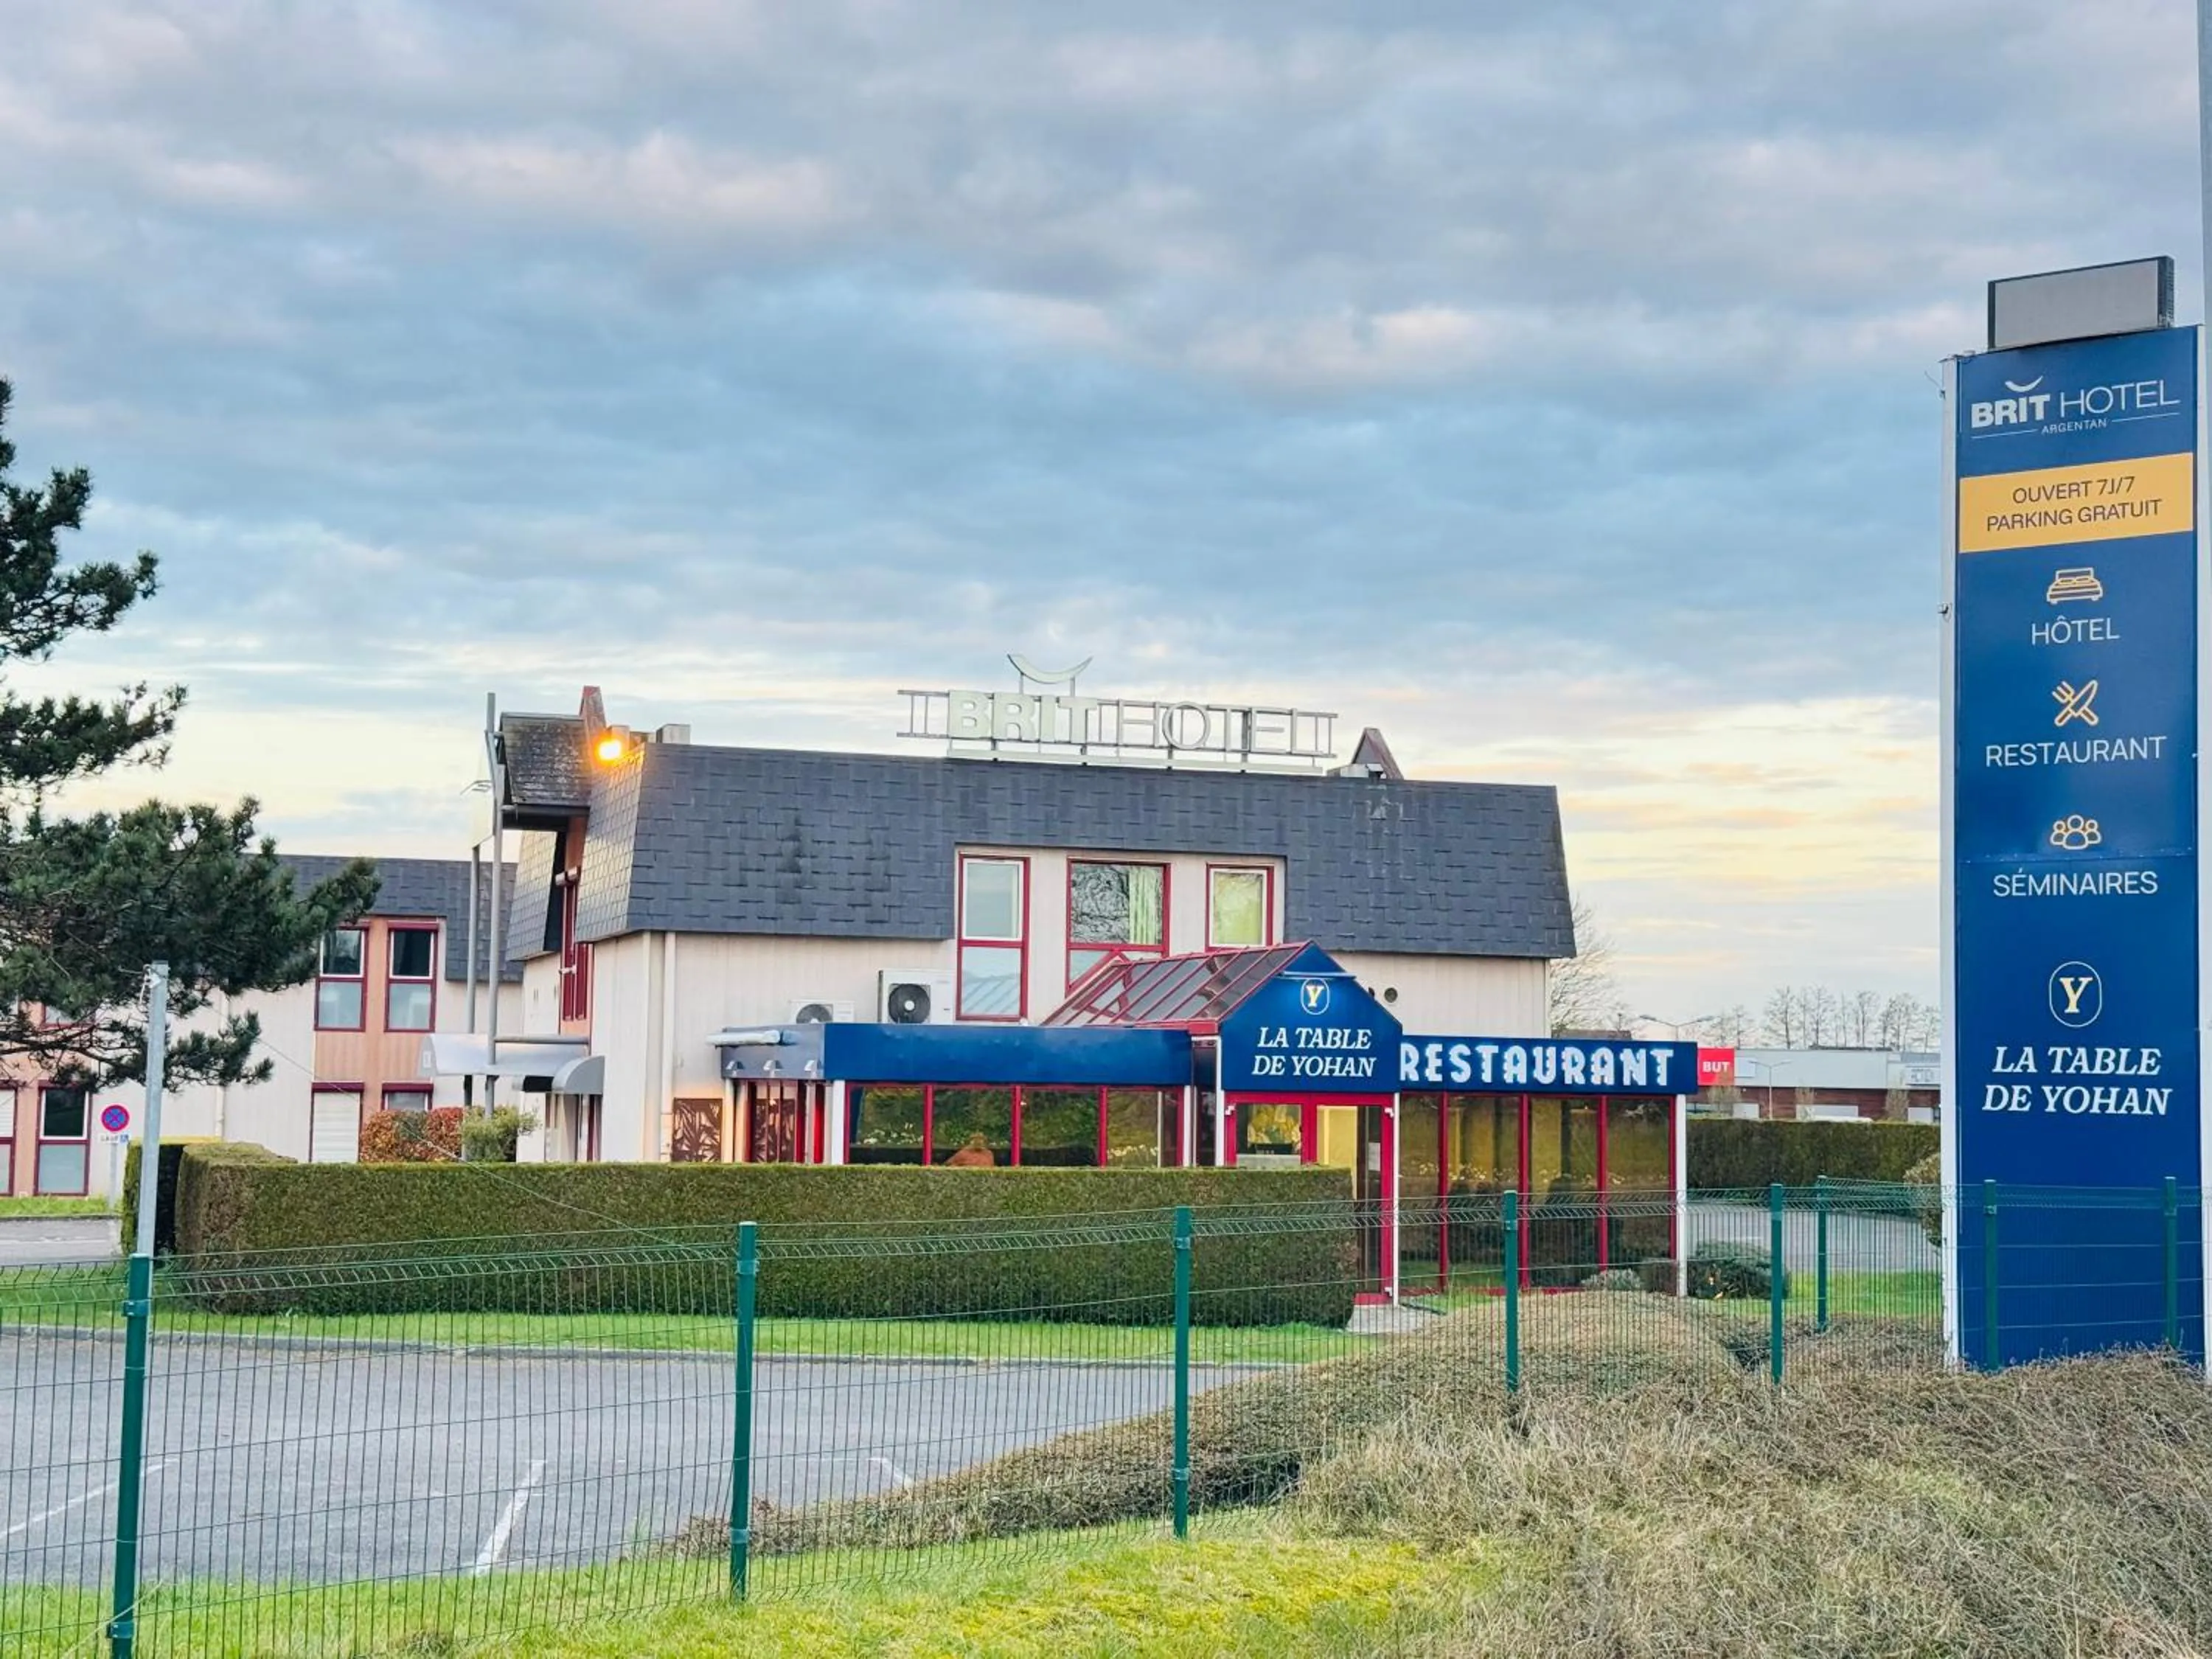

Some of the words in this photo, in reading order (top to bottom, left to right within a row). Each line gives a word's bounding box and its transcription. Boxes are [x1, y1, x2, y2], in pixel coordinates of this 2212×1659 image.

[1971, 394, 2050, 429] BRIT
[2060, 380, 2180, 418] HOTEL
[2041, 418, 2108, 435] ARGENTAN
[2012, 480, 2093, 504] OUVERT
[2096, 476, 2136, 495] 7J/7
[1986, 508, 2073, 532] PARKING
[2078, 498, 2162, 523] GRATUIT
[2031, 615, 2120, 645] HÔTEL
[947, 689, 1099, 744] BRIT
[1117, 700, 1324, 755] HOTEL
[1986, 736, 2167, 768] RESTAURANT
[1993, 868, 2158, 897] SÉMINAIRES
[1305, 984, 1325, 1008] Y
[2059, 976, 2094, 1014] Y
[1257, 1026, 1290, 1048] LA
[1295, 1026, 1372, 1050] TABLE
[1251, 1055, 1286, 1076] DE
[1291, 1055, 1377, 1077] YOHAN
[1400, 1043, 1674, 1086] RESTAURANT
[1703, 1061, 1731, 1073] BUT
[1992, 1046, 2038, 1074] LA
[2048, 1046, 2162, 1076] TABLE
[1982, 1085, 2033, 1112] DE
[2041, 1085, 2173, 1116] YOHAN
